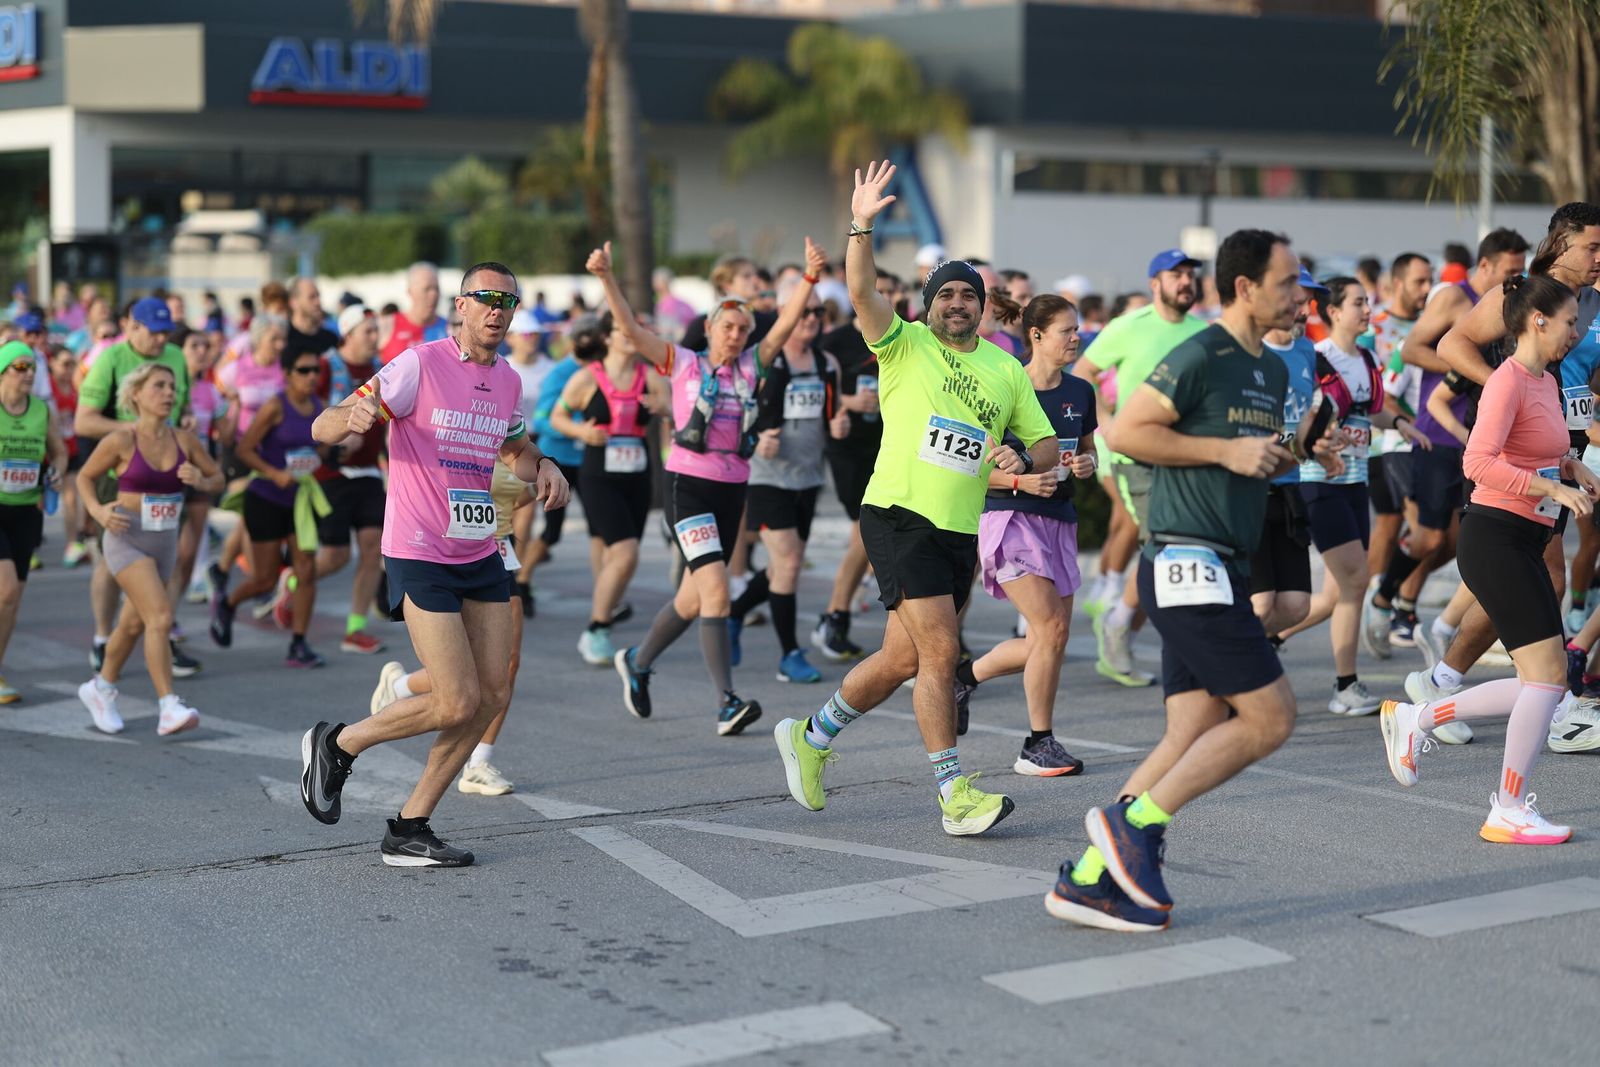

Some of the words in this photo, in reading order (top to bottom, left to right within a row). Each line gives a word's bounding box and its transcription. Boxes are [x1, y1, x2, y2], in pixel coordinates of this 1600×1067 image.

[250, 36, 430, 96] ALDI
[471, 399, 497, 415] XXXVI
[1570, 397, 1594, 417] 100
[430, 408, 472, 430] MEDIA
[435, 428, 495, 448] INTERNACIONAL
[929, 428, 982, 461] 1123
[453, 503, 494, 525] 1030
[1169, 562, 1217, 584] 813
